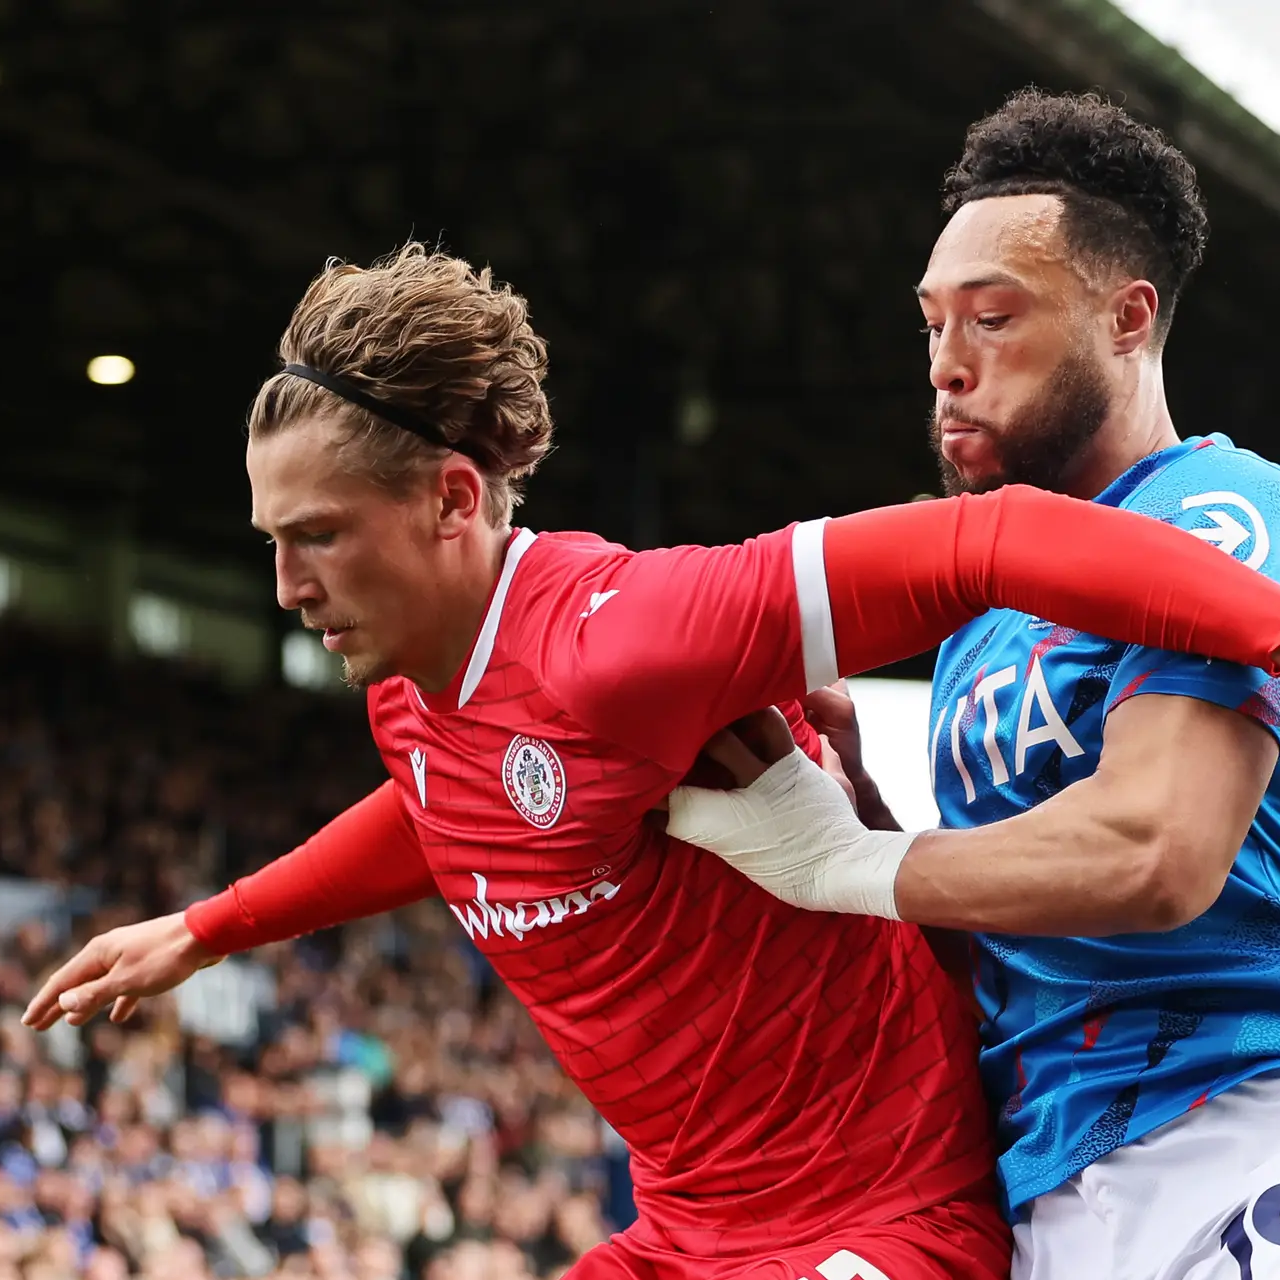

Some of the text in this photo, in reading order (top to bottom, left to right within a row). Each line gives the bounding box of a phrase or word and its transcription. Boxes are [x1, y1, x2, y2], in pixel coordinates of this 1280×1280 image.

[506, 736, 530, 786] ACCRINGTON
[531, 738, 559, 772] STANLEY
[516, 799, 551, 823] FOOTBALL
[550, 786, 562, 815] CLUB
